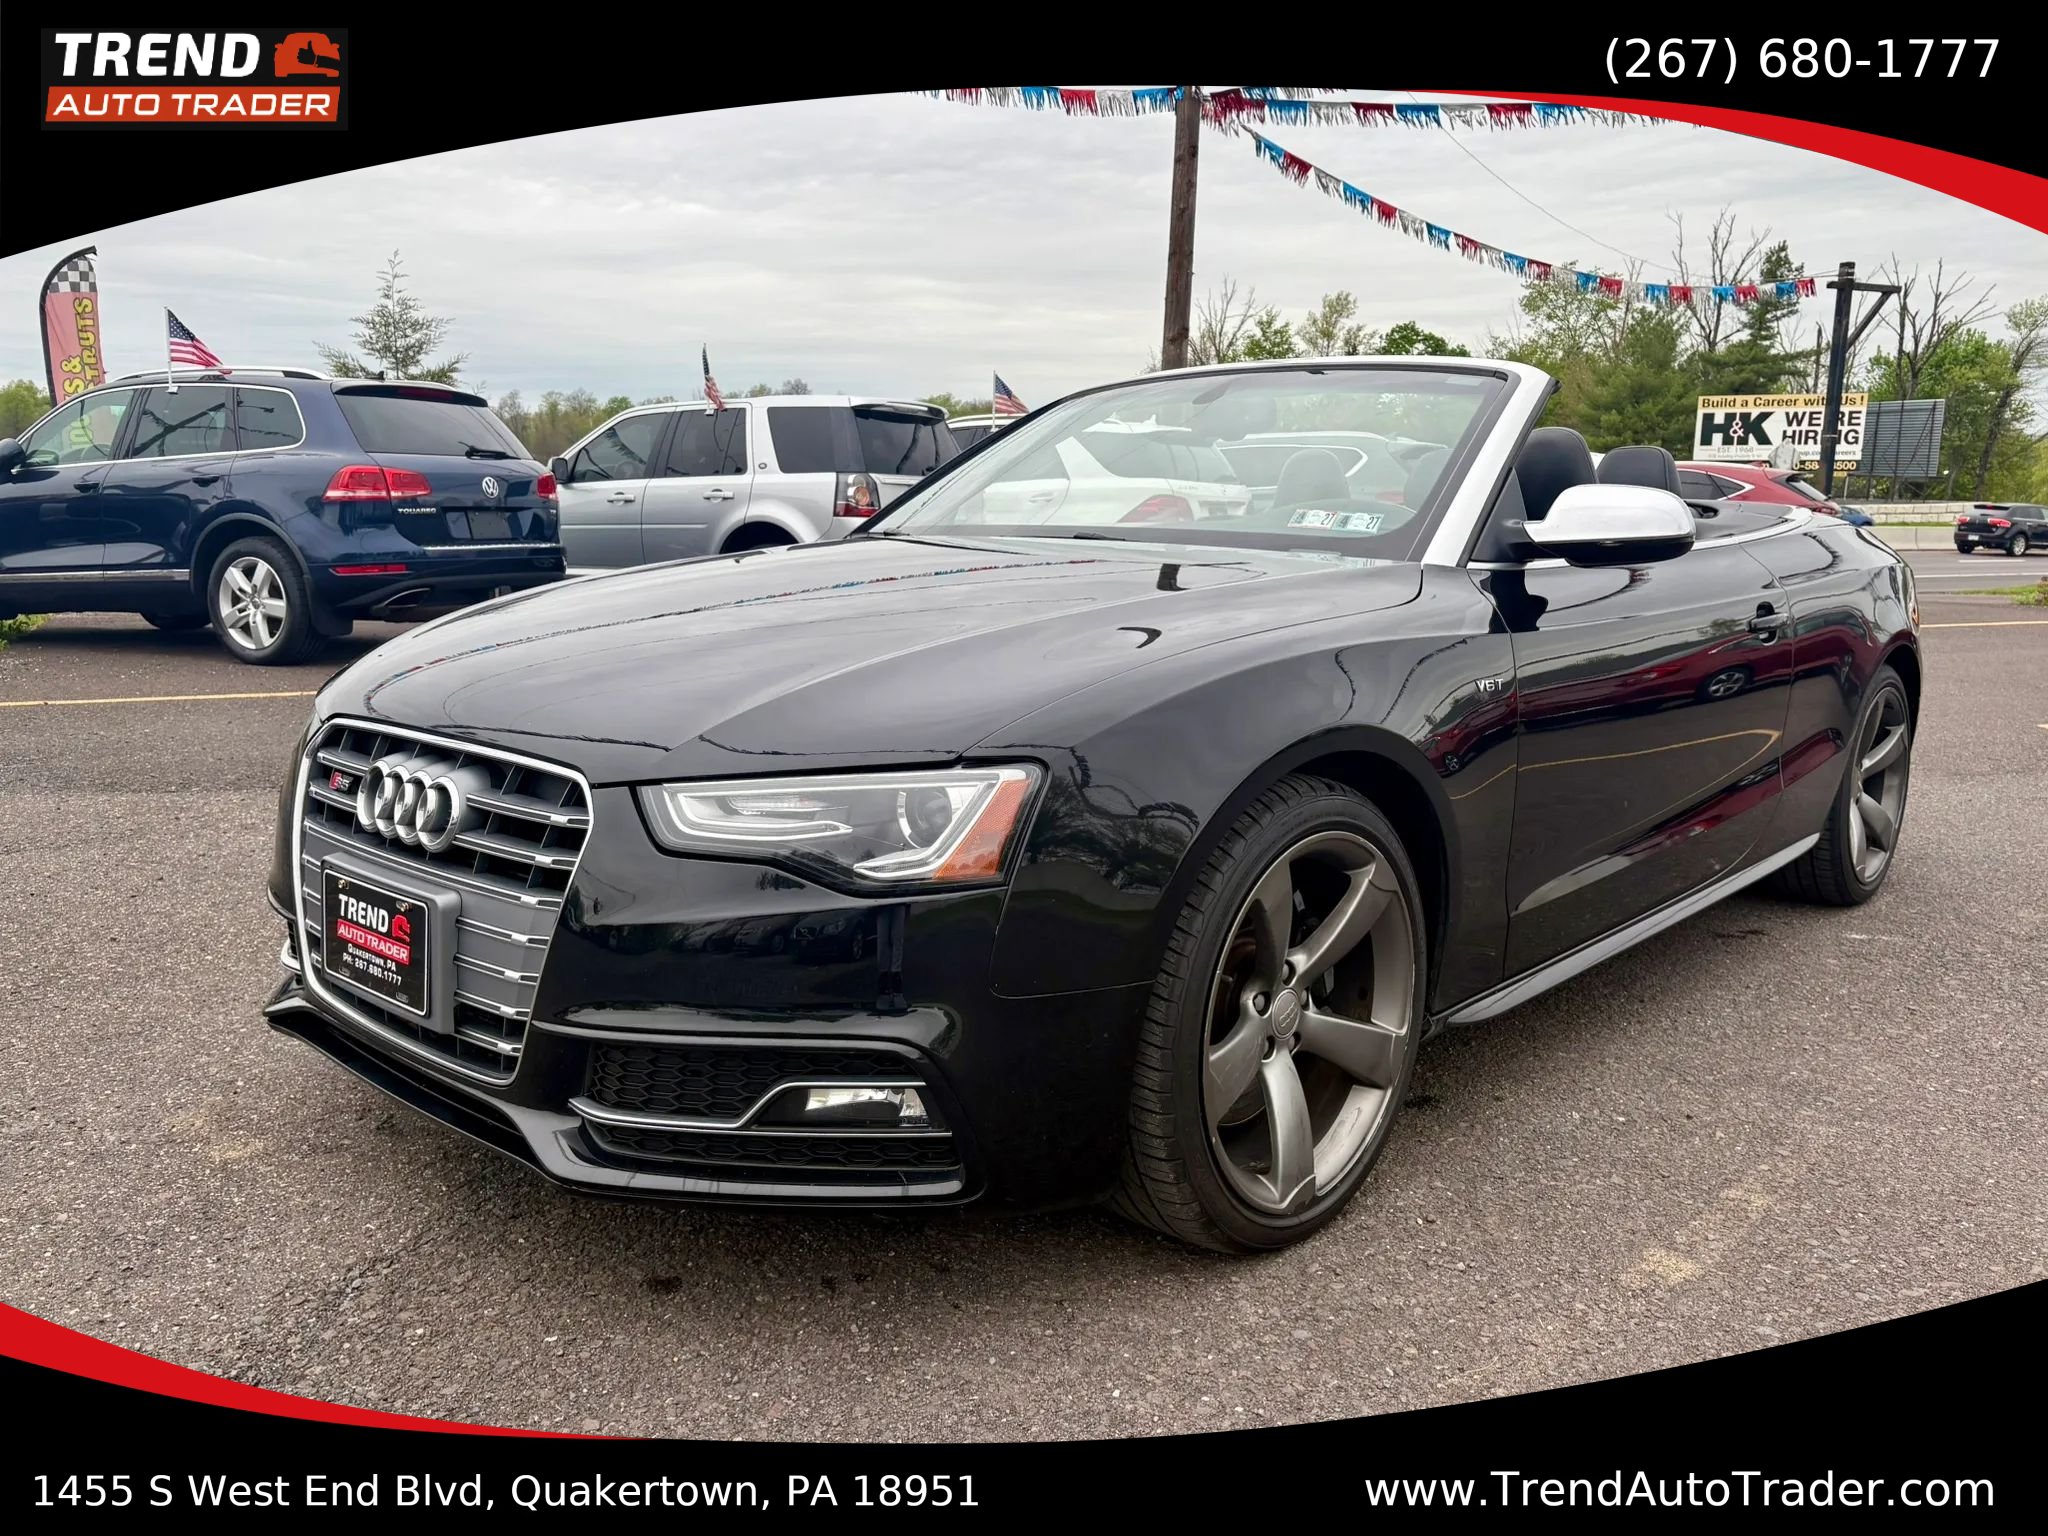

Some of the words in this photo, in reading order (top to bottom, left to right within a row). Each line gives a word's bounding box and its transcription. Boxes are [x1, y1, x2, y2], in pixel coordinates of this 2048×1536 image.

[1702, 397, 1737, 408] Build
[1740, 399, 1749, 408] a
[1753, 396, 1800, 408] Career
[1803, 395, 1826, 407] wit
[1365, 515, 1382, 531] 27
[1476, 678, 1504, 693] V6T
[338, 893, 389, 934] TREND
[337, 923, 366, 944] AUTO
[365, 933, 409, 961] TRADER
[354, 957, 402, 987] 267.680.1777
[386, 959, 397, 973] PA
